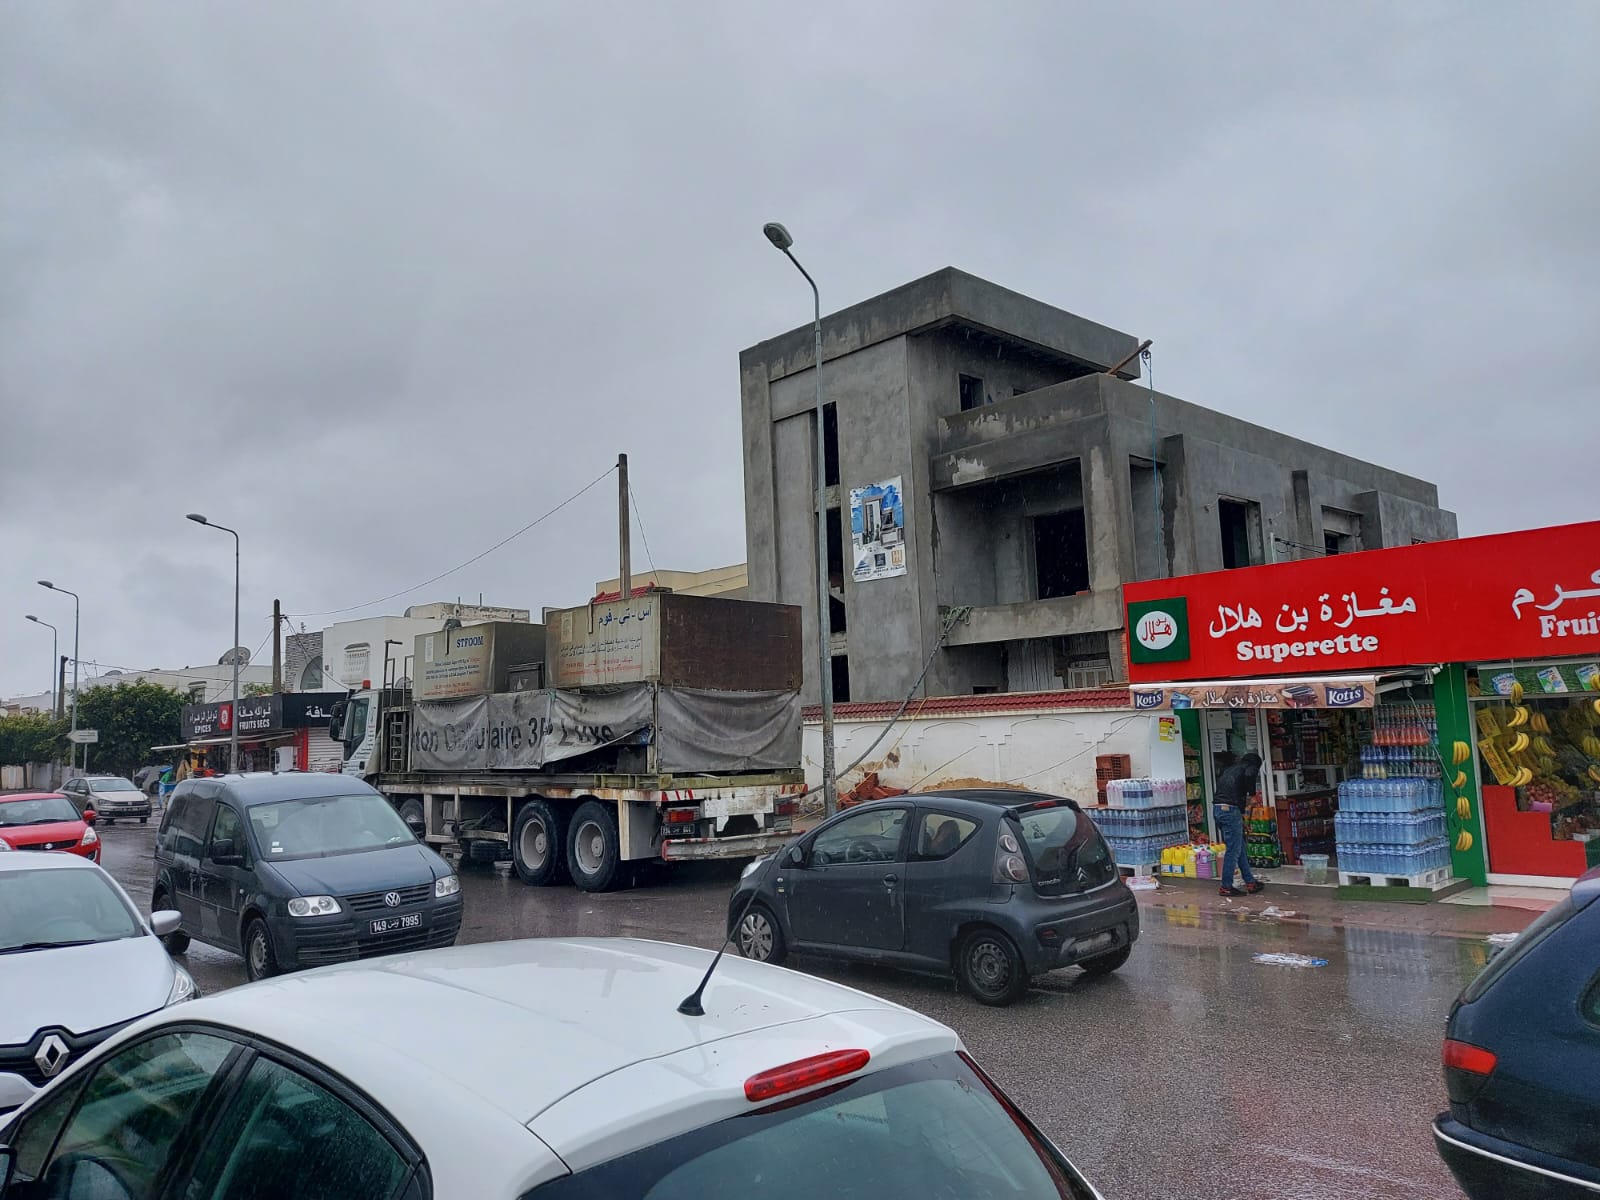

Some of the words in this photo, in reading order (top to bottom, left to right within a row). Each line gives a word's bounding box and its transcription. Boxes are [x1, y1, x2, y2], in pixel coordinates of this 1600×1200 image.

[1318, 587, 1416, 627] مغازة
[1209, 603, 1262, 638] هلال
[1275, 604, 1309, 632] بن
[1539, 612, 1600, 638] Frui
[1237, 634, 1378, 662] Superette
[1203, 690, 1224, 706] هلال
[1229, 696, 1244, 708] بن
[1248, 690, 1278, 706] مغازة
[239, 720, 257, 730] FRUITS
[257, 719, 270, 729] SECS
[373, 920, 386, 932] 149
